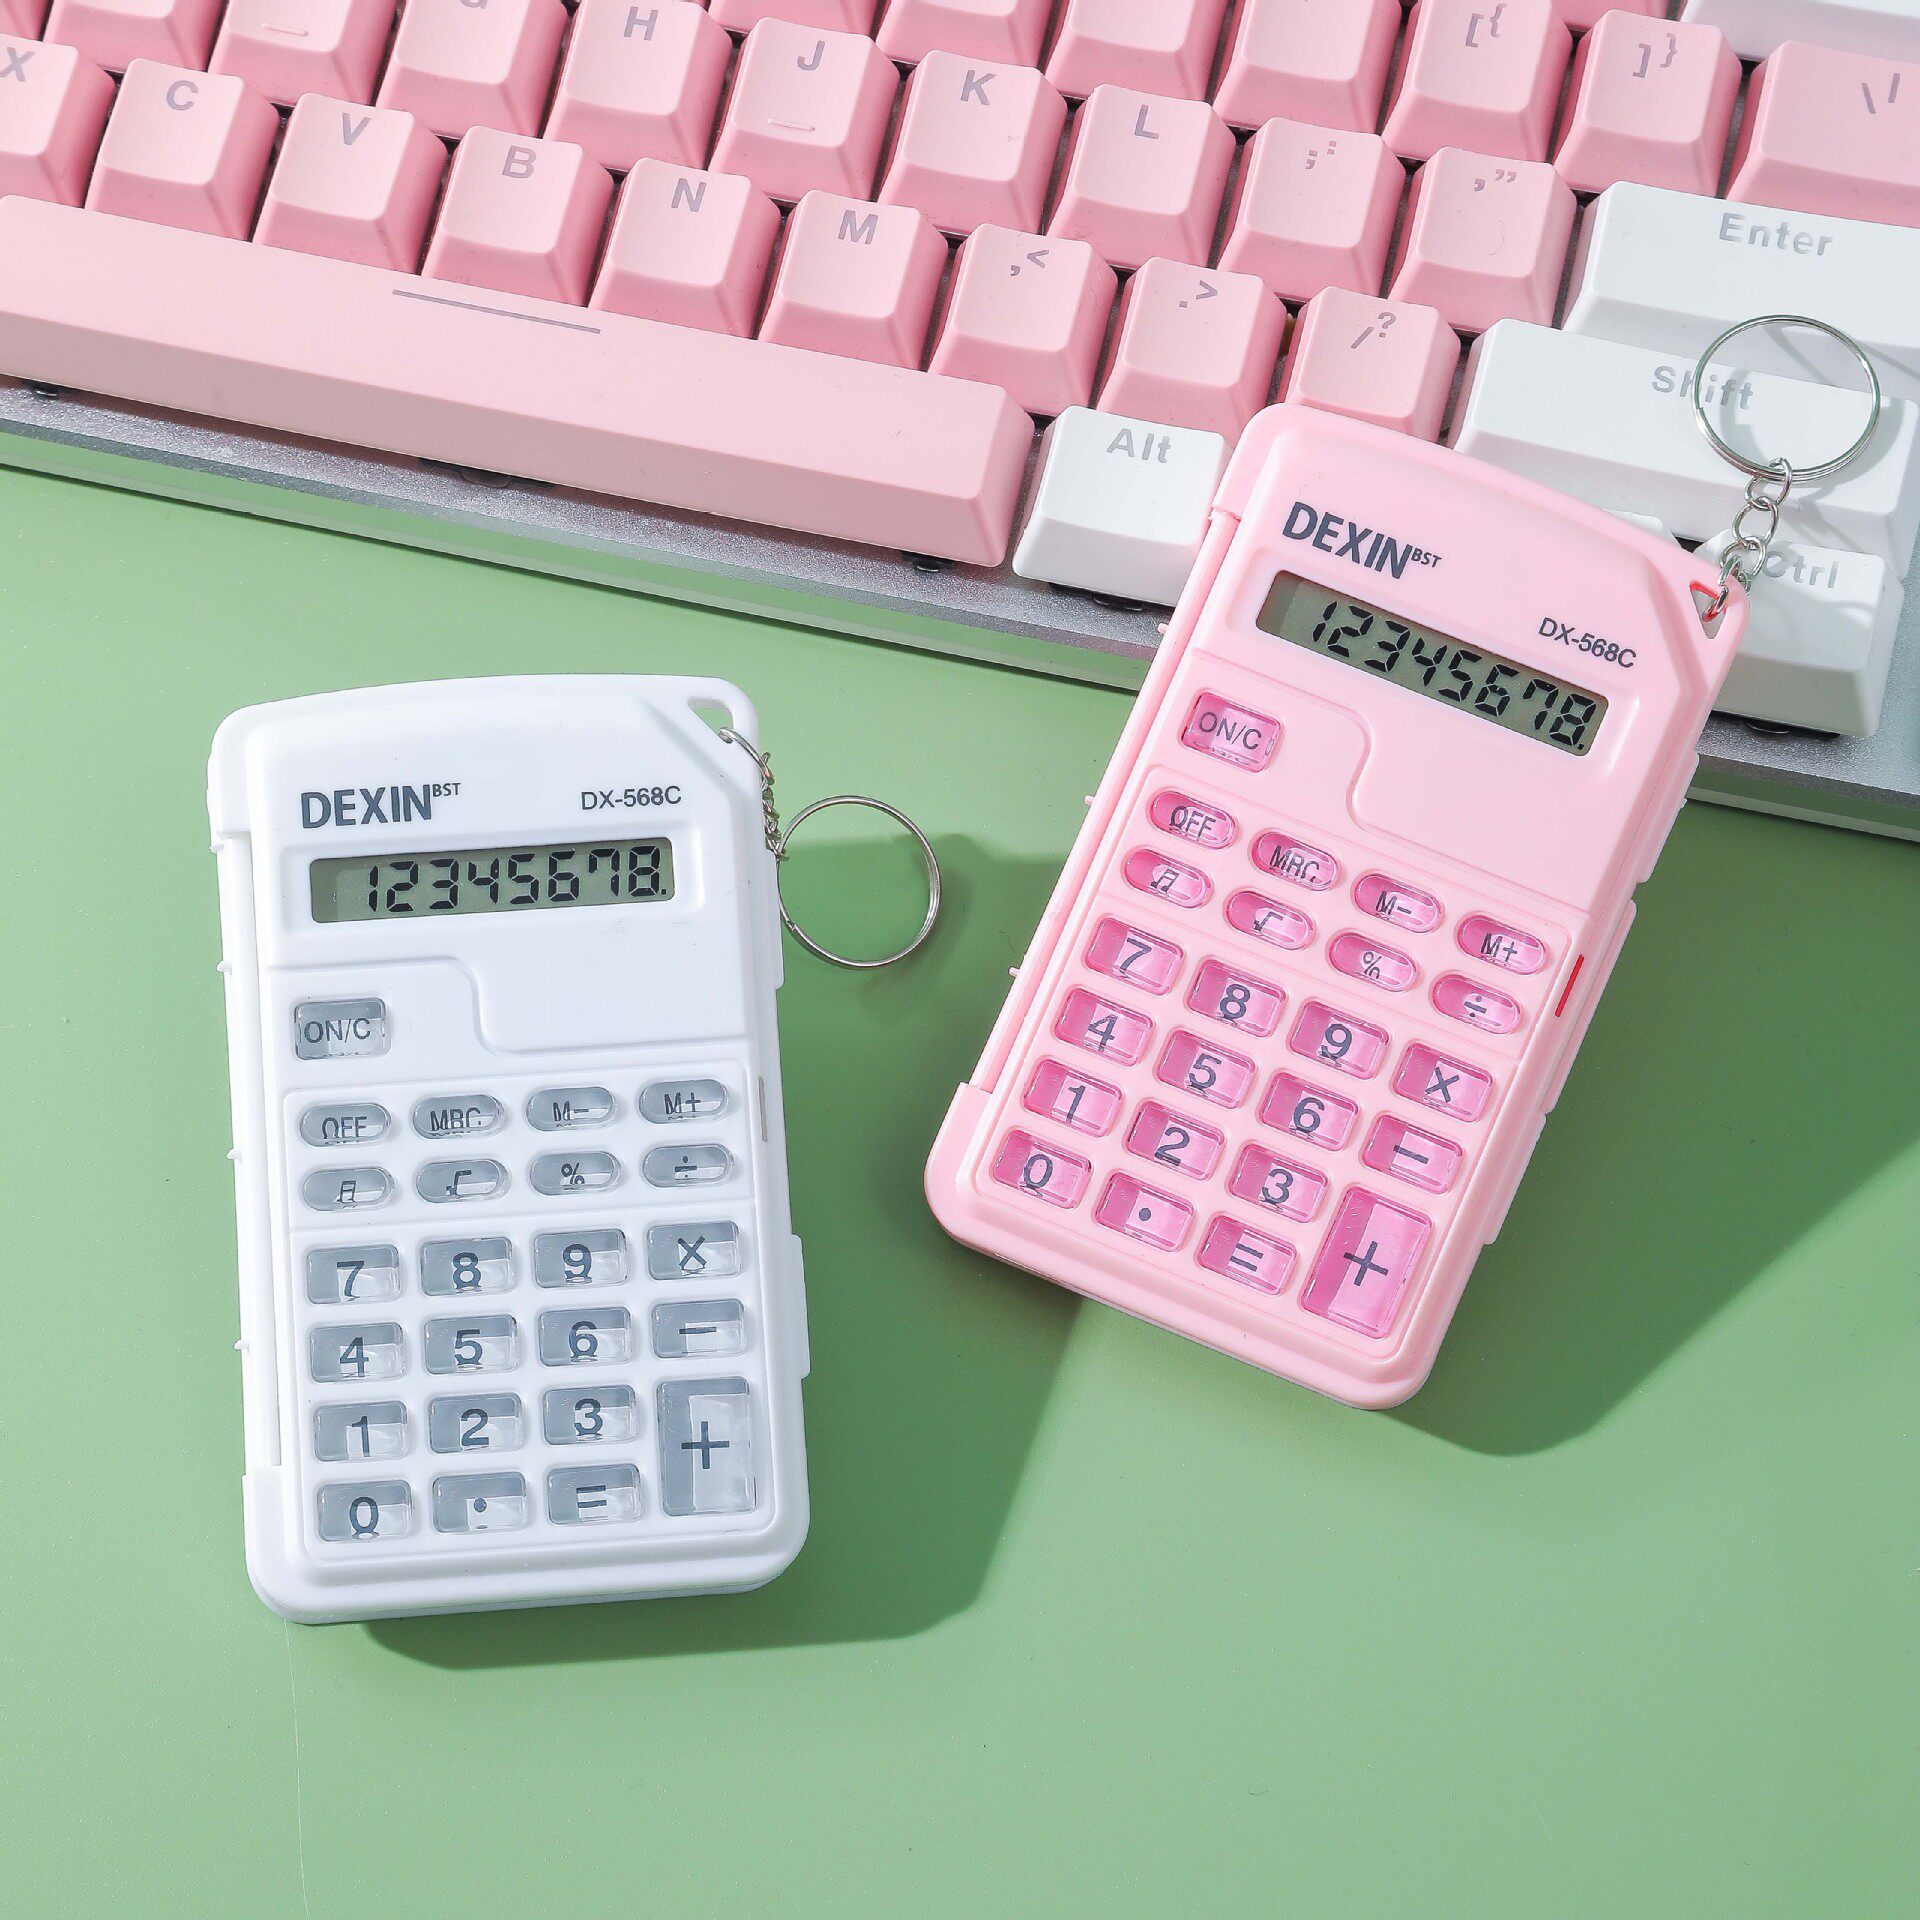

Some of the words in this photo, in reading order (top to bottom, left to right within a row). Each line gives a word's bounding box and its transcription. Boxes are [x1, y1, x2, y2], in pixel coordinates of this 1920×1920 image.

[623, 6, 659, 41] H
[0, 47, 35, 82] X
[797, 40, 825, 71] J
[166, 80, 198, 111] C
[960, 69, 995, 106] K
[340, 113, 371, 146] V
[1133, 105, 1159, 140] L
[501, 145, 536, 179] B
[671, 178, 706, 212] N
[838, 210, 879, 245] M
[1719, 212, 1833, 257] Enter
[1106, 429, 1172, 464] Alt
[1282, 502, 1413, 579] DEXIN
[1762, 551, 1838, 589] Ctrl
[1538, 617, 1637, 669] DX-568C
[1199, 711, 1262, 751] ON/C
[301, 784, 433, 829] DEXIN
[581, 785, 682, 810] DX-568C
[1169, 806, 1217, 840] OFF
[1270, 845, 1320, 883] MRC
[1116, 938, 1153, 977] 7
[1481, 933, 1518, 964] M+
[1220, 983, 1251, 1020] 8
[304, 1017, 371, 1044] ON/C
[1088, 1015, 1116, 1050] 4
[1320, 1023, 1353, 1061] 9
[1189, 1056, 1223, 1092] 5
[664, 1092, 701, 1115] M+
[1065, 1085, 1084, 1124] 1
[1293, 1096, 1325, 1134] 6
[321, 1116, 367, 1139] OFF
[1155, 1127, 1190, 1165] 2
[1022, 1153, 1054, 1192] 0
[1261, 1167, 1294, 1205] 3
[337, 1261, 364, 1297] 7
[452, 1252, 481, 1288] 8
[562, 1244, 592, 1278] 9
[454, 1328, 483, 1364] 5
[569, 1320, 598, 1357] 6
[339, 1337, 369, 1377] 4
[461, 1409, 490, 1446] 2
[574, 1398, 603, 1435] 3
[351, 1415, 370, 1457] 1
[349, 1496, 379, 1533] 0
